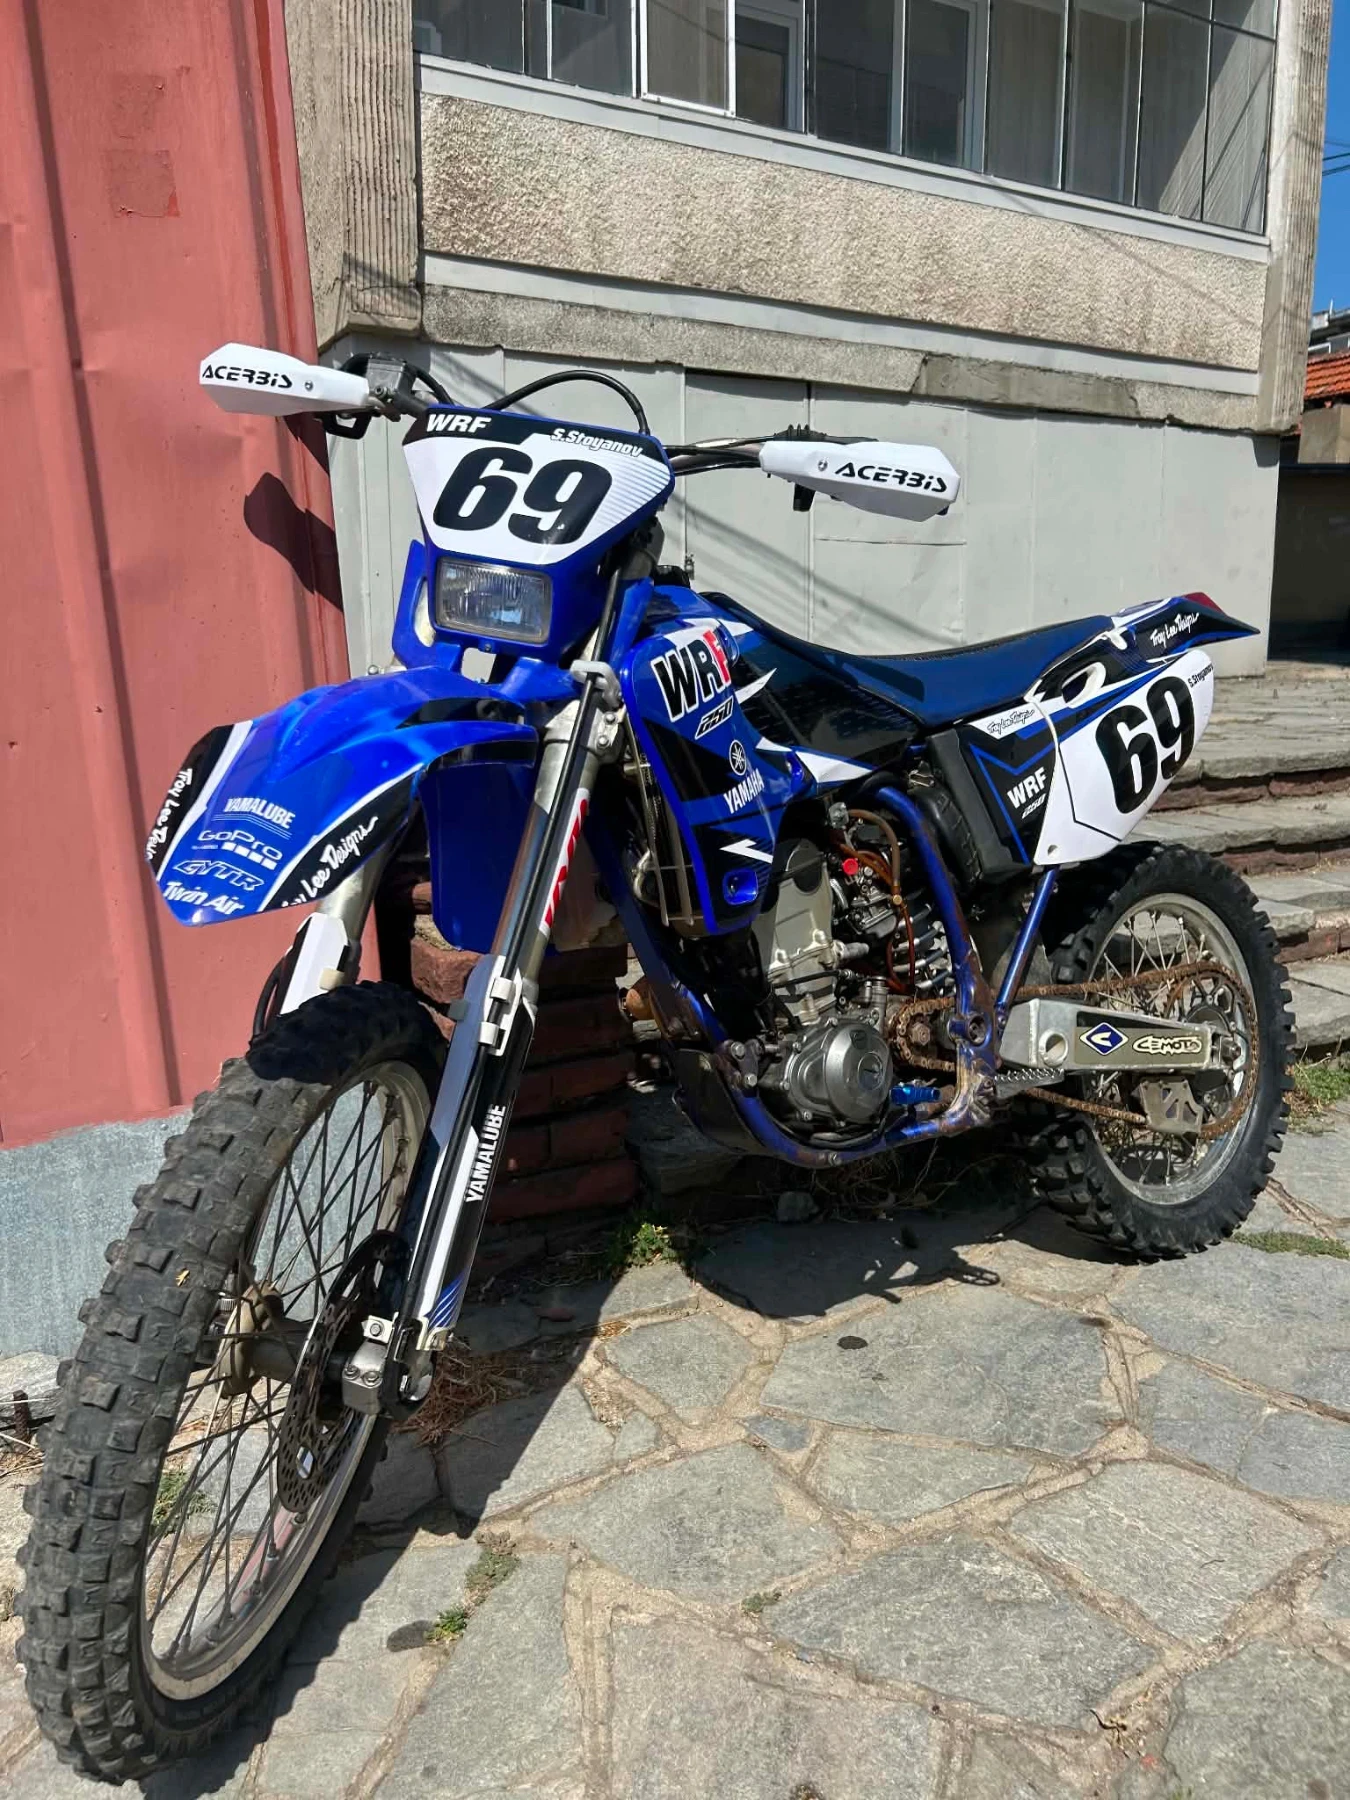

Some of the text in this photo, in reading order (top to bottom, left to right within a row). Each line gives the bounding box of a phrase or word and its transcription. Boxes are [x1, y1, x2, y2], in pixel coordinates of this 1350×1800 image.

[426, 413, 491, 433] WRF
[550, 428, 643, 458] S.Stoyanov
[433, 446, 612, 545] 69
[650, 629, 731, 722] WRF
[697, 699, 733, 738] 250
[1095, 676, 1195, 814] 69
[168, 768, 193, 797] Troy
[723, 768, 765, 814] YAMAHA
[1007, 766, 1047, 809] WRF
[157, 799, 180, 827] Lee
[223, 797, 296, 829] YAMALUBE
[197, 830, 283, 861] GoPro
[172, 860, 265, 891] GYTR
[301, 868, 330, 898] Lee
[163, 881, 245, 915] Twin Air
[465, 1103, 506, 1203] YAMALUBE
